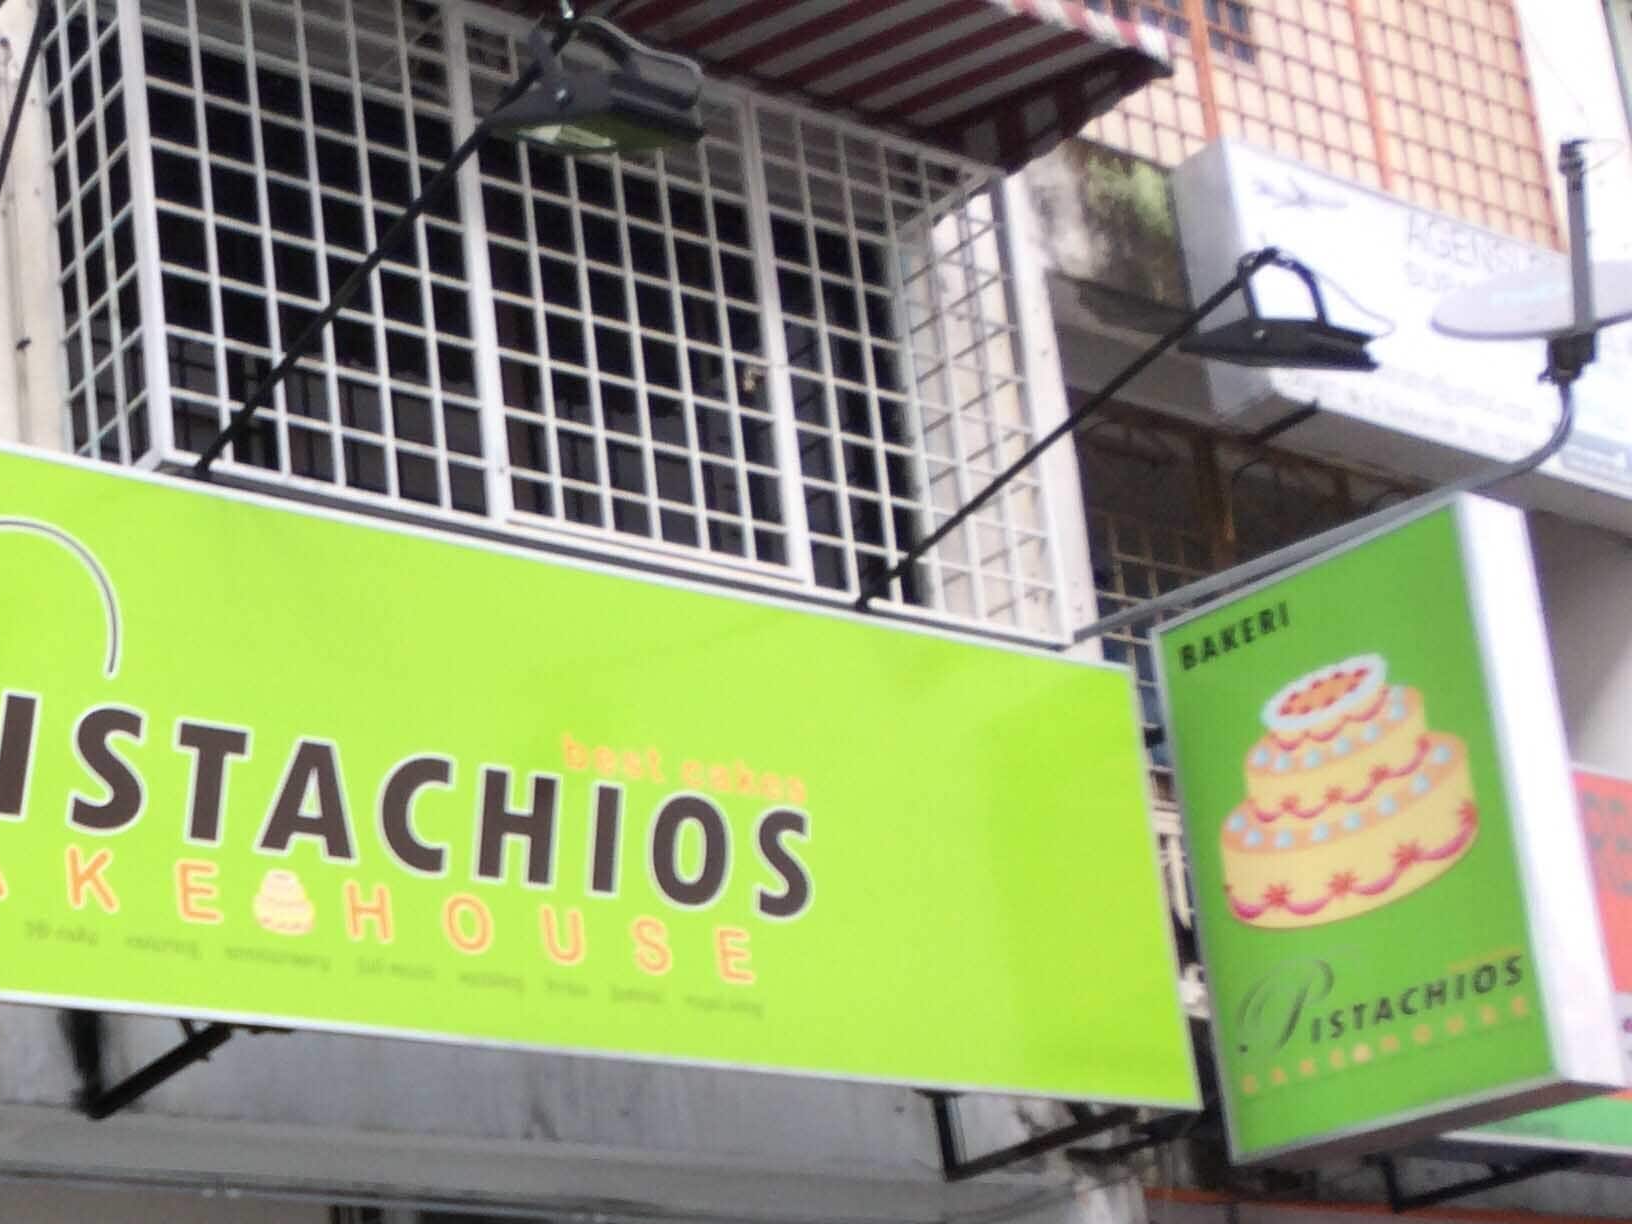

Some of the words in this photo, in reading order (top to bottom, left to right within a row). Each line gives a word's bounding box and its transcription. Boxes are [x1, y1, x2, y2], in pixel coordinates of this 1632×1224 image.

[1179, 600, 1290, 671] BAKERI
[344, 881, 756, 983] HOUSE
[1237, 946, 1524, 1055] PISTACHIOS
